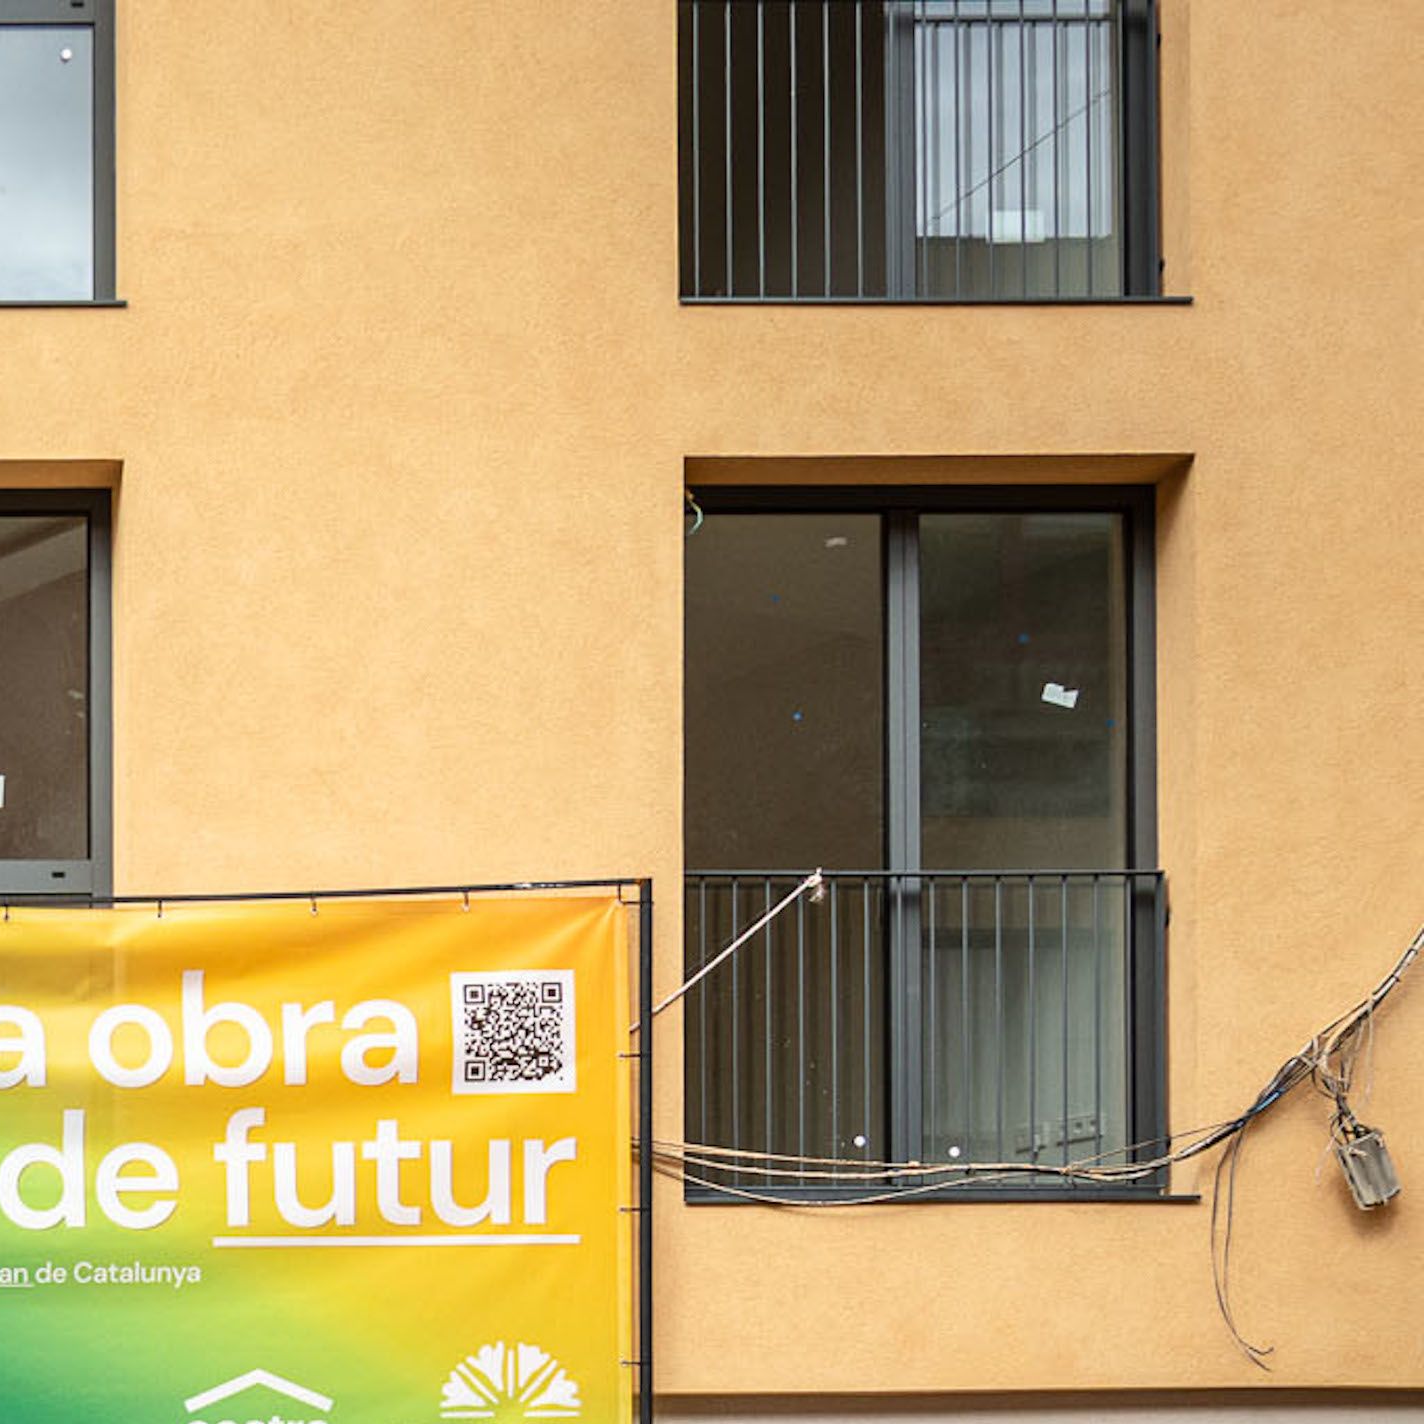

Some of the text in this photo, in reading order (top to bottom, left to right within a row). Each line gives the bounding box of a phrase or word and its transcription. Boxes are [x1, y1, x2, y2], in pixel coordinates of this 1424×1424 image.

[87, 969, 419, 1088] obra
[213, 1108, 576, 1227] futur
[34, 1262, 67, 1284] de
[73, 1261, 201, 1289] Catalunya
